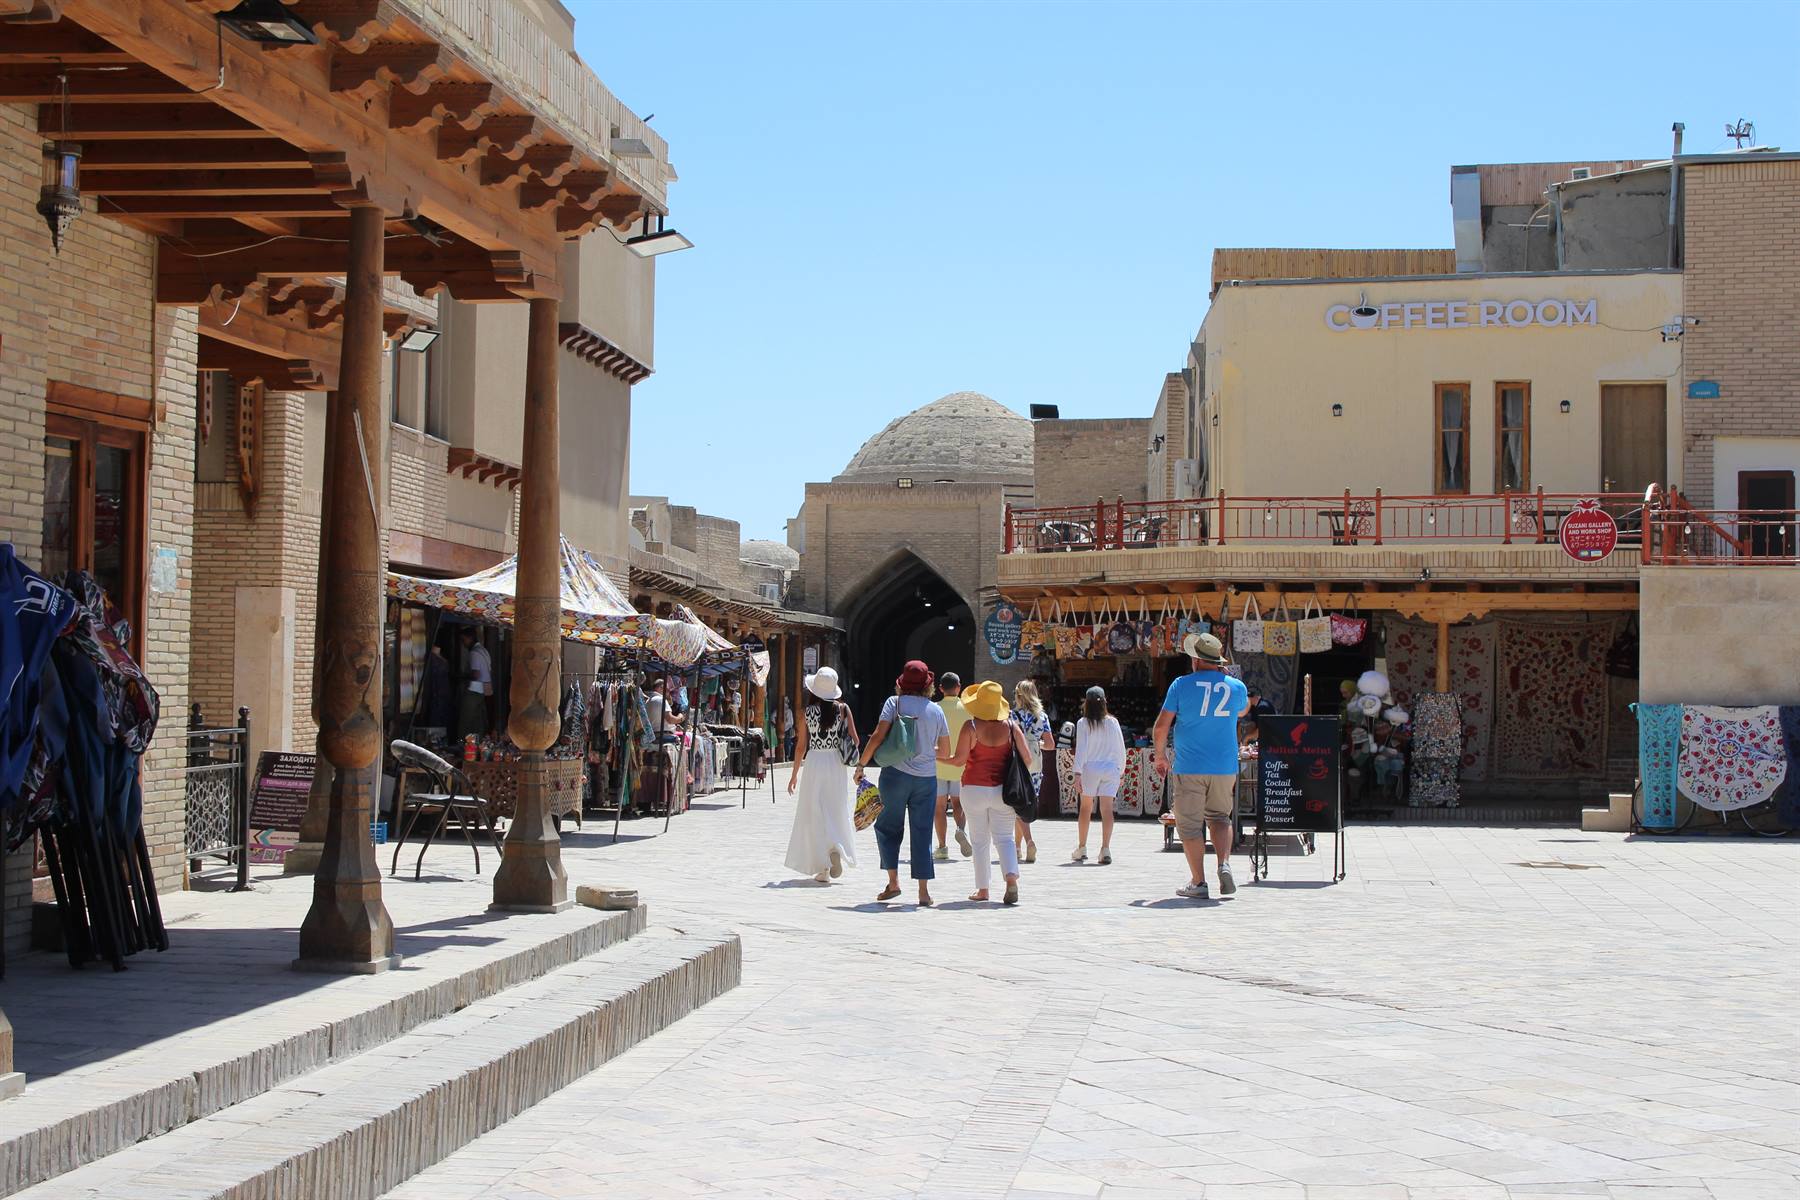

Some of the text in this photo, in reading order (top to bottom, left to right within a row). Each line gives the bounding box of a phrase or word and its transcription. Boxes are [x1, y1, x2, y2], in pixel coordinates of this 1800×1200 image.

[1325, 299, 1597, 331] COFFEE ROOM
[1196, 681, 1230, 716] 72
[1265, 761, 1288, 771] Coffee
[1265, 788, 1303, 797] Breakfast
